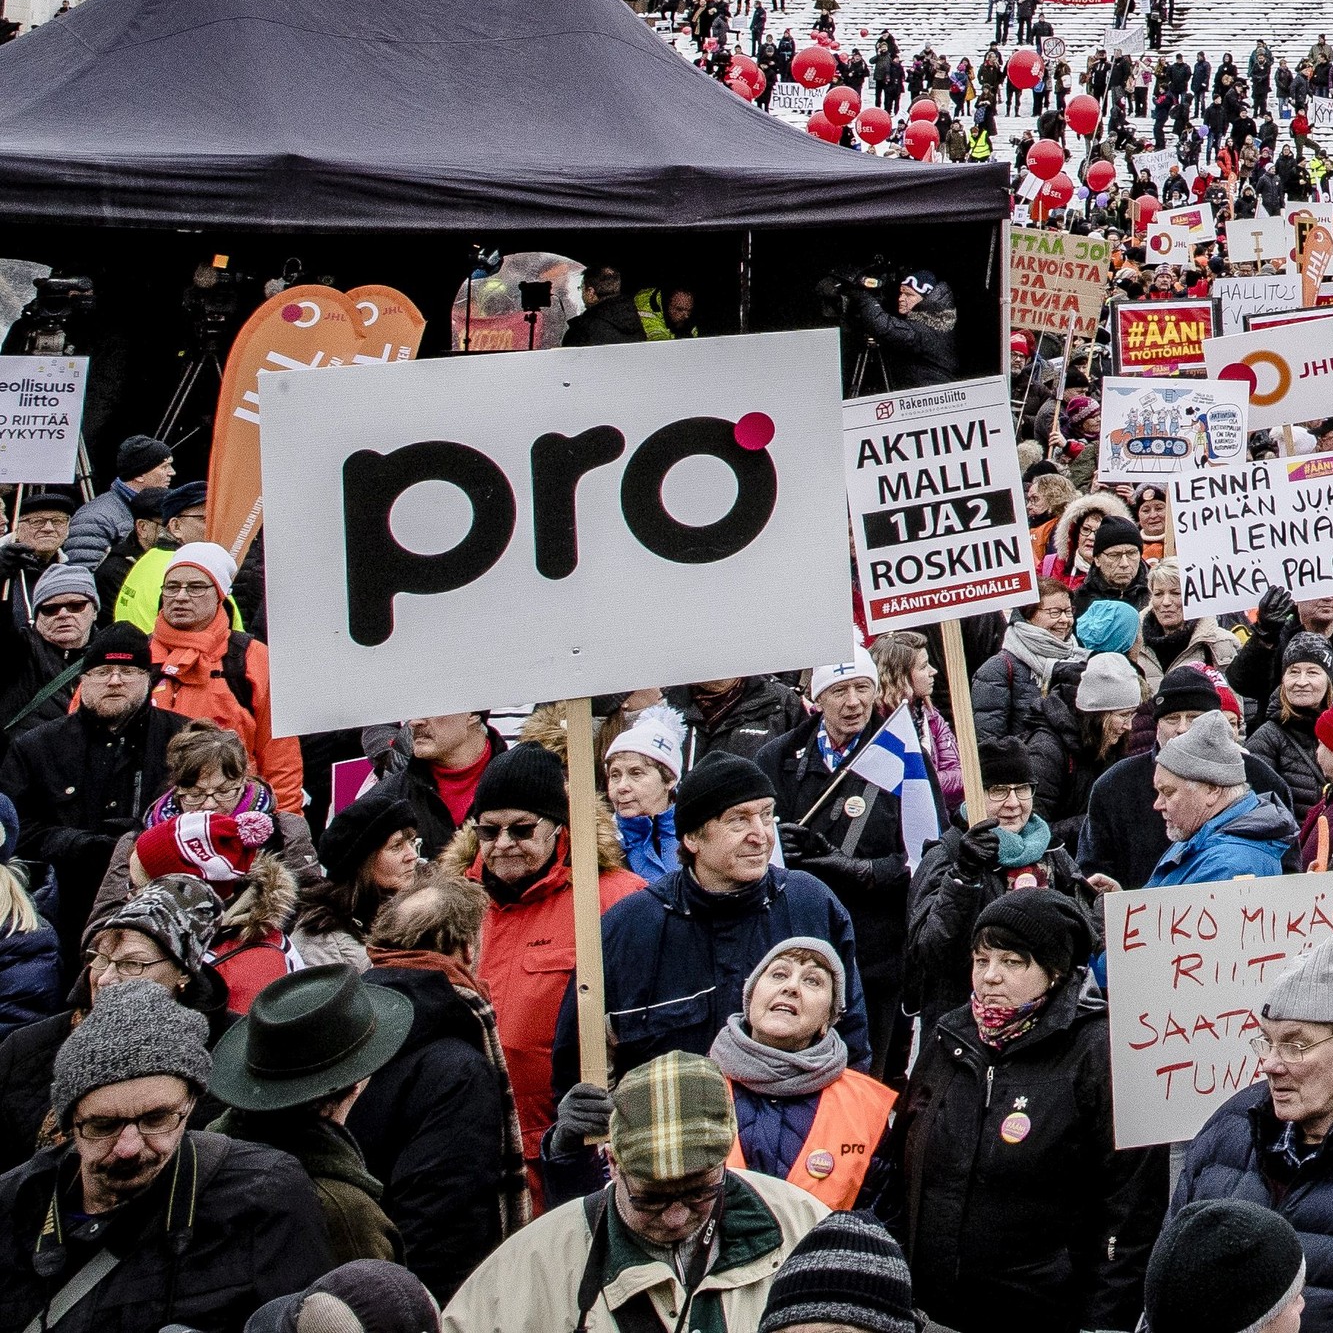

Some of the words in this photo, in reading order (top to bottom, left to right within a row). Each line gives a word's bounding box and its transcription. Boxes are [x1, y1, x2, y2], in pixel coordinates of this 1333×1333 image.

[1075, 241, 1112, 263] JO!
[1174, 240, 1187, 248] JHL
[1220, 283, 1296, 301] HALLITUS
[1128, 315, 1206, 348] #ÄÄNI
[19, 393, 59, 407] liitto
[899, 389, 967, 411] Rakennusliitto
[12, 414, 69, 426] RIITTÄÄ
[856, 419, 1002, 469] AKTIIVI-
[878, 458, 992, 505] MALLI
[1174, 466, 1271, 504] LENNÄ
[342, 411, 778, 647] pro
[890, 512, 908, 542] 1
[919, 504, 963, 538] JA
[967, 499, 992, 529] 2
[1178, 495, 1276, 535] SIPILÄN
[1231, 508, 1333, 555] LENNÄ
[870, 536, 1021, 591] ROSKIIN
[1183, 555, 1270, 607] ÄLÄKÄ
[882, 578, 1020, 615] #ÄÄNITYÖTTÖMÄLLE
[840, 1143, 865, 1158] pro
[702, 1218, 717, 1246] EOS
